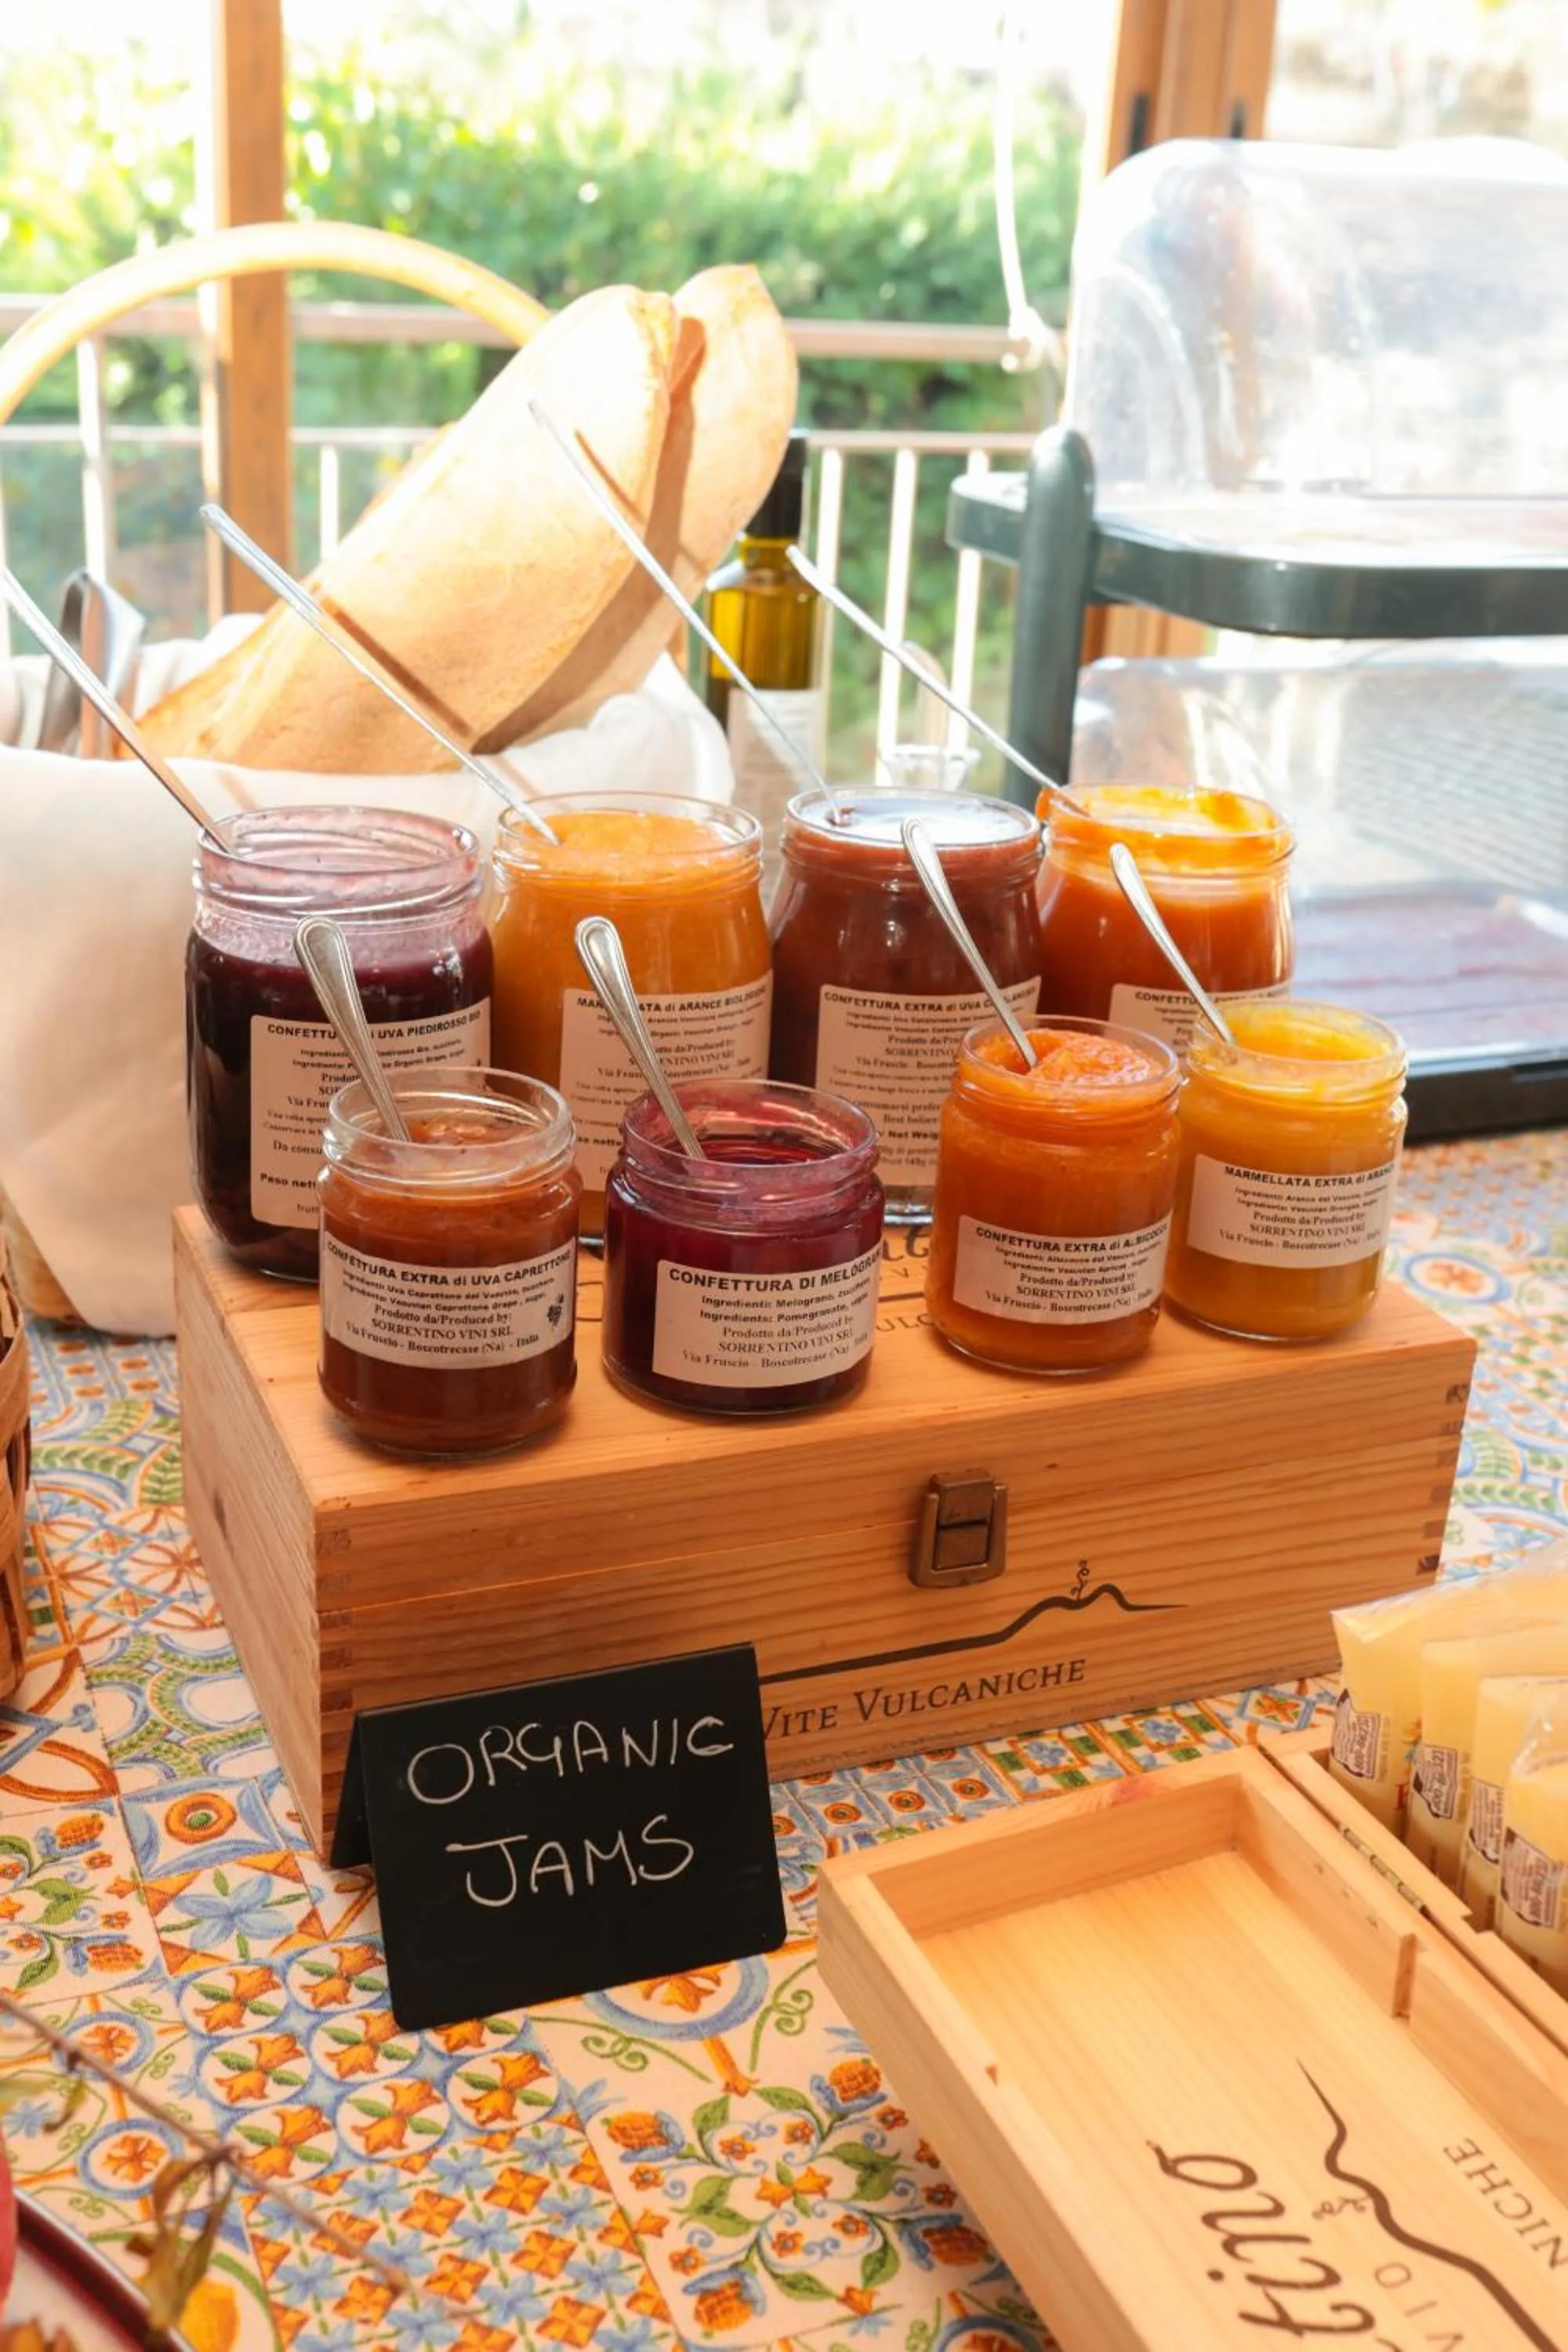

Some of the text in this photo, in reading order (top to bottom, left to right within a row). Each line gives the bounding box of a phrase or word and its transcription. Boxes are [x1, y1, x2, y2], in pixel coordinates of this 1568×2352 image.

[664, 1003, 675, 1012] di
[679, 1000, 722, 1011] ARANCE
[825, 992, 901, 1011] CONFETTURA
[905, 1003, 942, 1011] EXTRA
[959, 1001, 980, 1011] UVA
[267, 1024, 336, 1040] CONFETTU
[378, 1029, 404, 1040] UVA
[407, 1016, 467, 1037] PIEDIROSSO
[912, 1131, 939, 1140] Weig
[260, 1172, 317, 1189] Peso nett
[1225, 1166, 1311, 1187] MARMELLATA
[1314, 1177, 1353, 1188] EXTRA
[1356, 1174, 1365, 1184] di
[1254, 1211, 1297, 1224] Prodotto
[976, 1226, 1120, 1252] CONFETTURA EXTRA di
[1250, 1224, 1325, 1239] SORRENTINO
[327, 1241, 571, 1287] CONFETTURA EXTRA di UVA CAPRETTONE
[670, 1268, 793, 1291] CONFETTURA
[799, 1276, 815, 1290] DI
[1020, 1272, 1064, 1286] Prodotto
[387, 1285, 405, 1294] Uva
[1016, 1285, 1094, 1300] SORRENTINO
[985, 1290, 1001, 1303] Via
[1004, 1295, 1041, 1310] Fruscio
[374, 1305, 421, 1323] Prodotto
[423, 1313, 494, 1325] da/Produced
[346, 1320, 359, 1335] Via
[361, 1328, 398, 1348] Fruscio
[408, 1341, 479, 1355] Boscotrecase
[372, 1318, 456, 1340] SORRENTINO
[459, 1329, 488, 1340] VINI
[723, 1326, 774, 1338] Prodotto
[718, 1339, 808, 1353] SORRENTINO
[706, 1354, 750, 1367] Fruscio
[854, 1659, 1086, 1722] VULCANICHE
[407, 1715, 735, 1805] ORGANIC
[445, 1814, 695, 1907] JAMS
